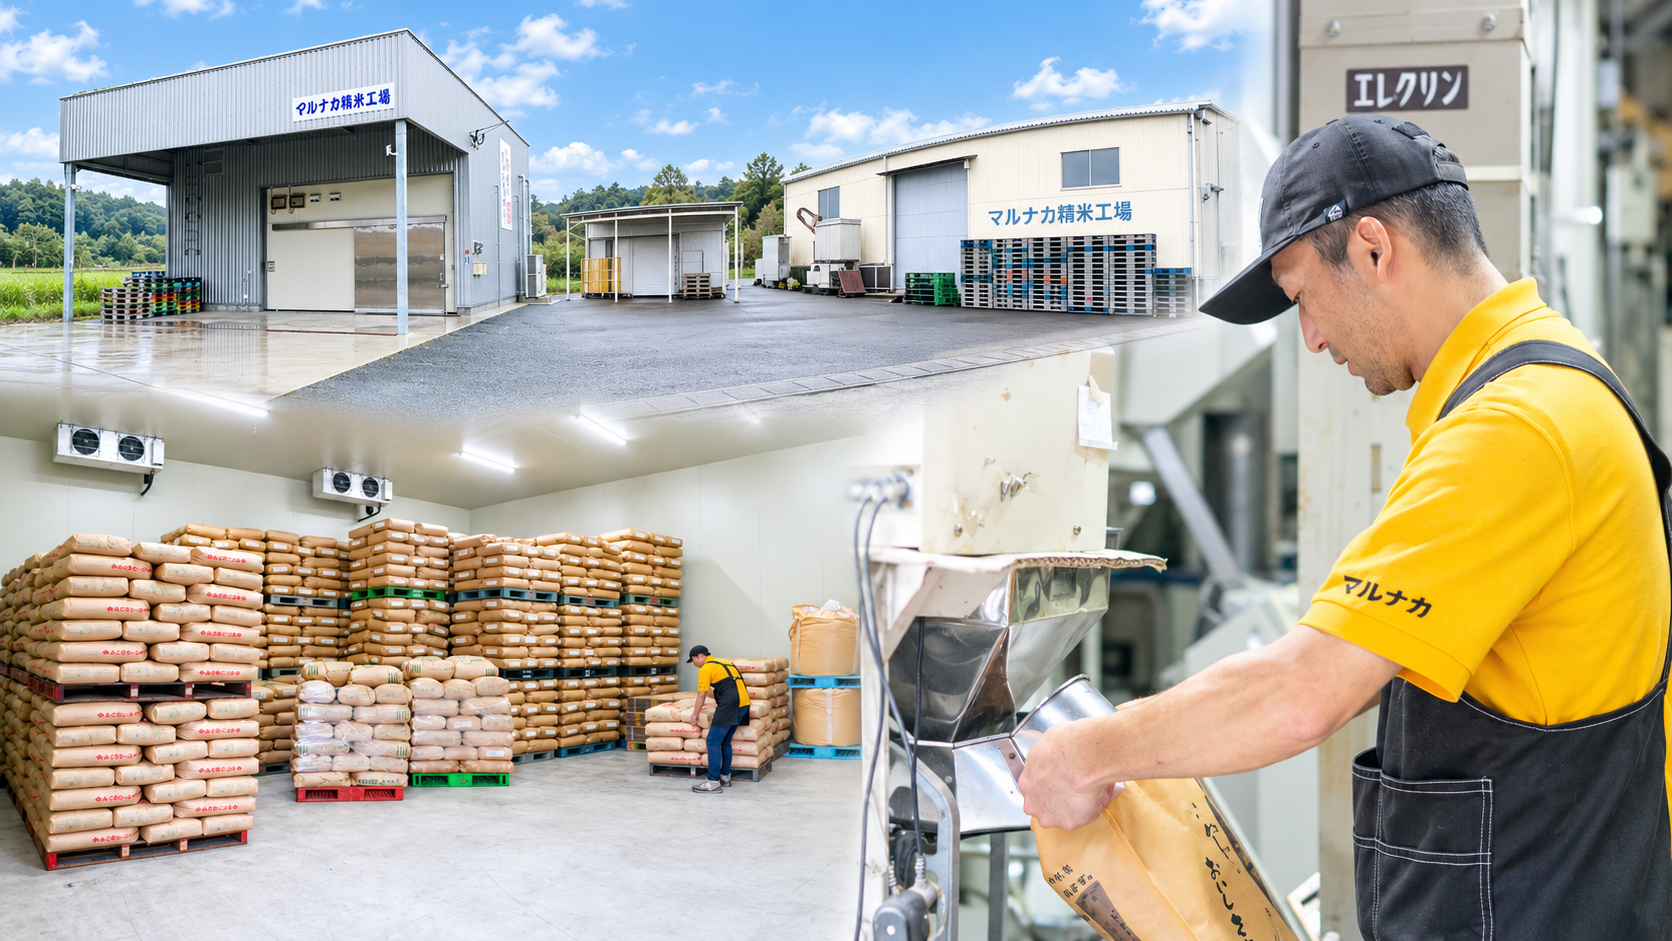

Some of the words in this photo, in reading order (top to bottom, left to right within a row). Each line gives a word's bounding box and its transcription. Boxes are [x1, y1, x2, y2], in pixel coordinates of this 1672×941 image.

[295, 88, 391, 116] マルナカ精米工場
[1354, 70, 1462, 109] エレクリン
[988, 201, 1133, 226] マルナカ精米工場
[1343, 575, 1433, 619] マルナカ
